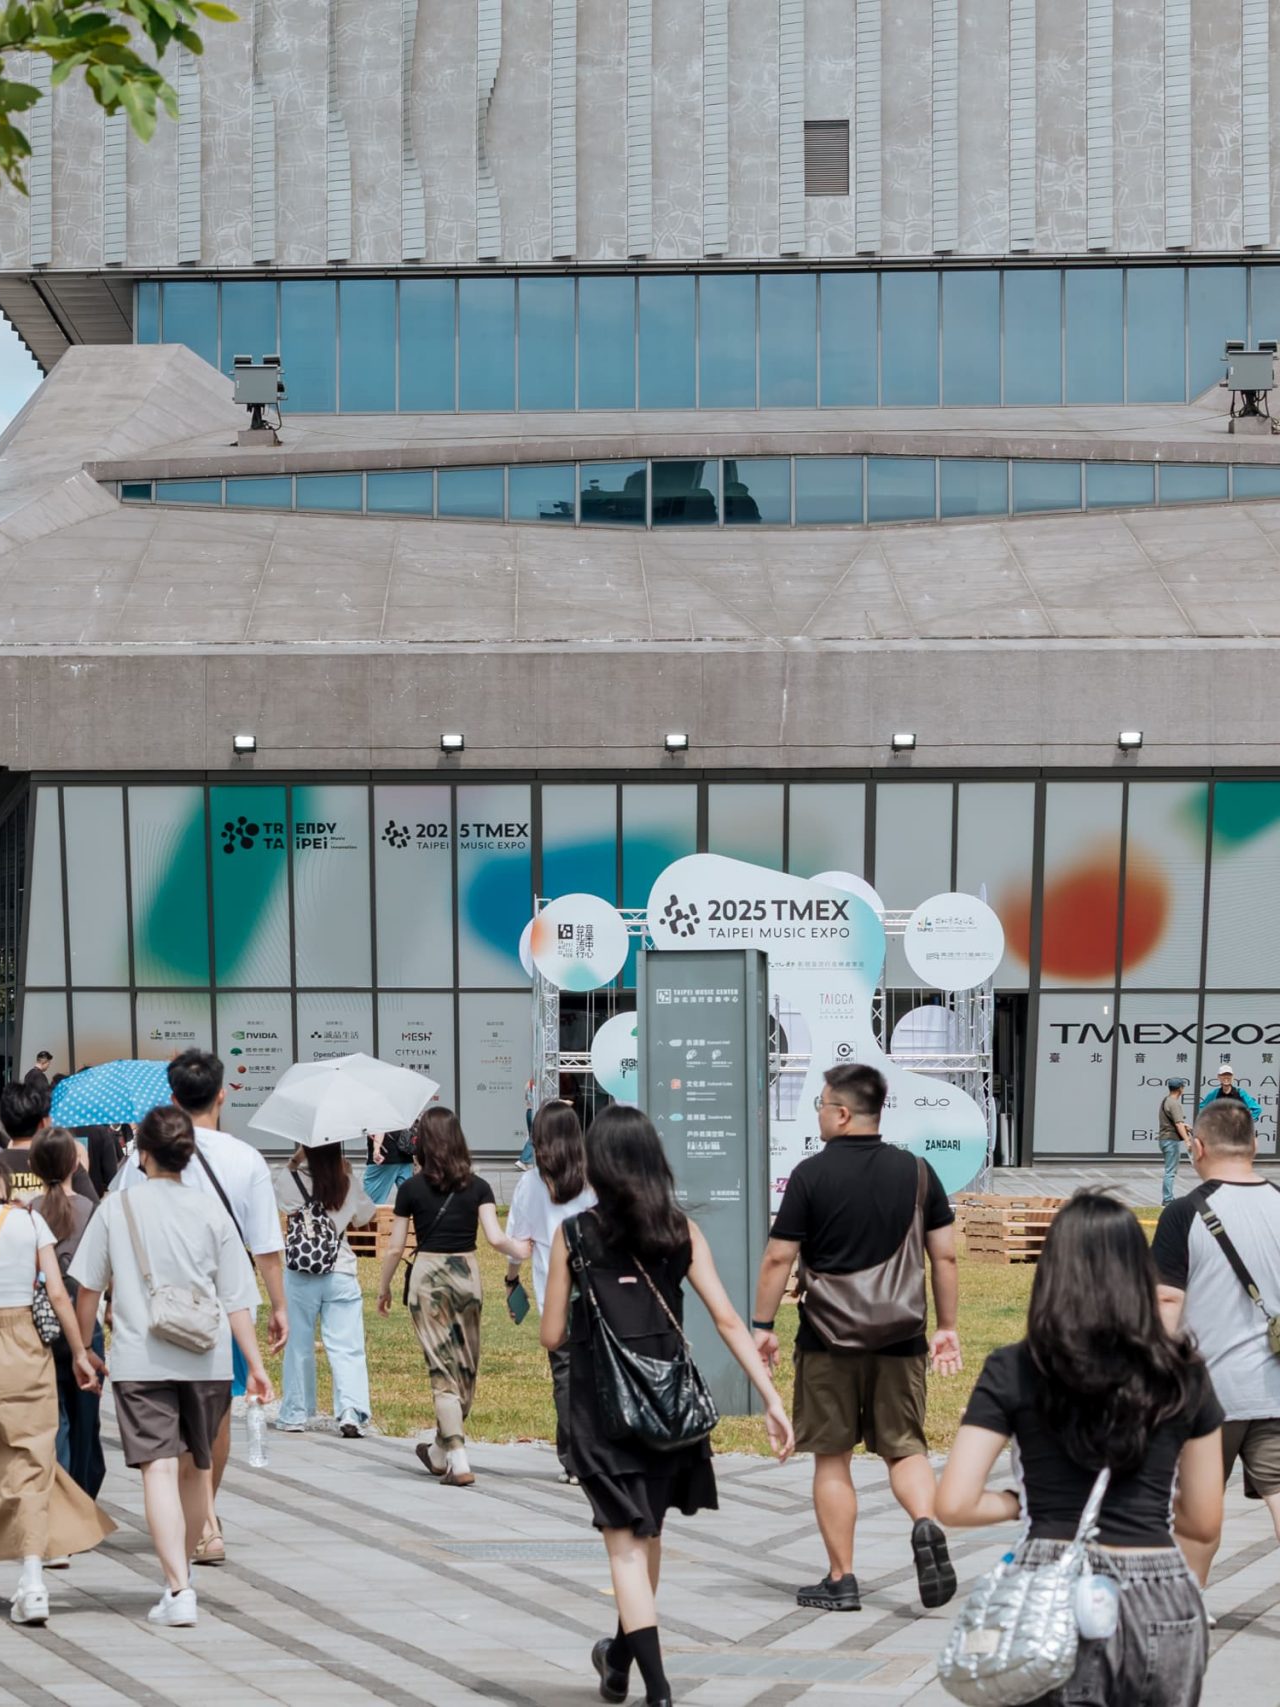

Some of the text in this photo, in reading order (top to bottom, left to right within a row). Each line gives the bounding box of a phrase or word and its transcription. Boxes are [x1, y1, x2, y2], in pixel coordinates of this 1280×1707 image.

[415, 823, 529, 839] 2025 TMEX
[416, 842, 526, 850] TAIPEI MUSIC EXPO
[708, 900, 850, 921] 2025 TMEX
[708, 928, 850, 938] TAIPEI MUSIC EXPO
[914, 1096, 950, 1107] duo
[925, 1140, 960, 1151] ZANDARI
